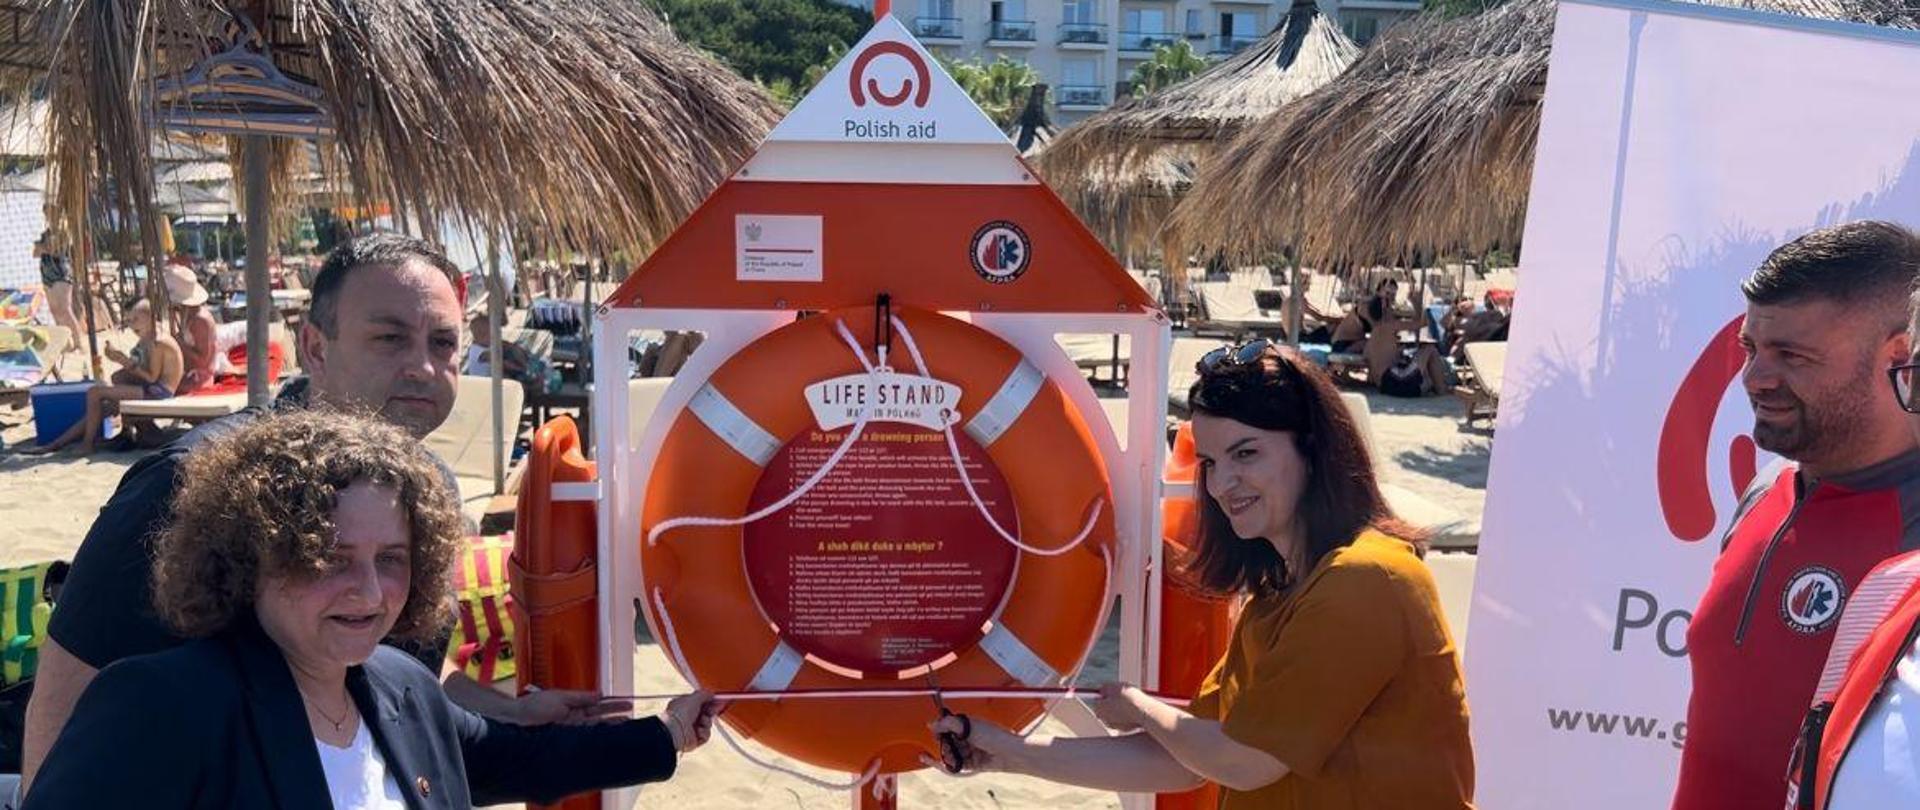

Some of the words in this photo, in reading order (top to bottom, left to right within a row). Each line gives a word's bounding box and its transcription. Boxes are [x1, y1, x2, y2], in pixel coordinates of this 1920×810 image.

[845, 120, 900, 138] Polish
[907, 121, 936, 139] aid
[823, 385, 865, 405] LIFE
[879, 384, 946, 405] STAND
[811, 432, 823, 442] Do
[824, 433, 841, 443] you
[870, 431, 912, 443] drowning
[913, 433, 945, 443] person
[818, 541, 825, 551] A
